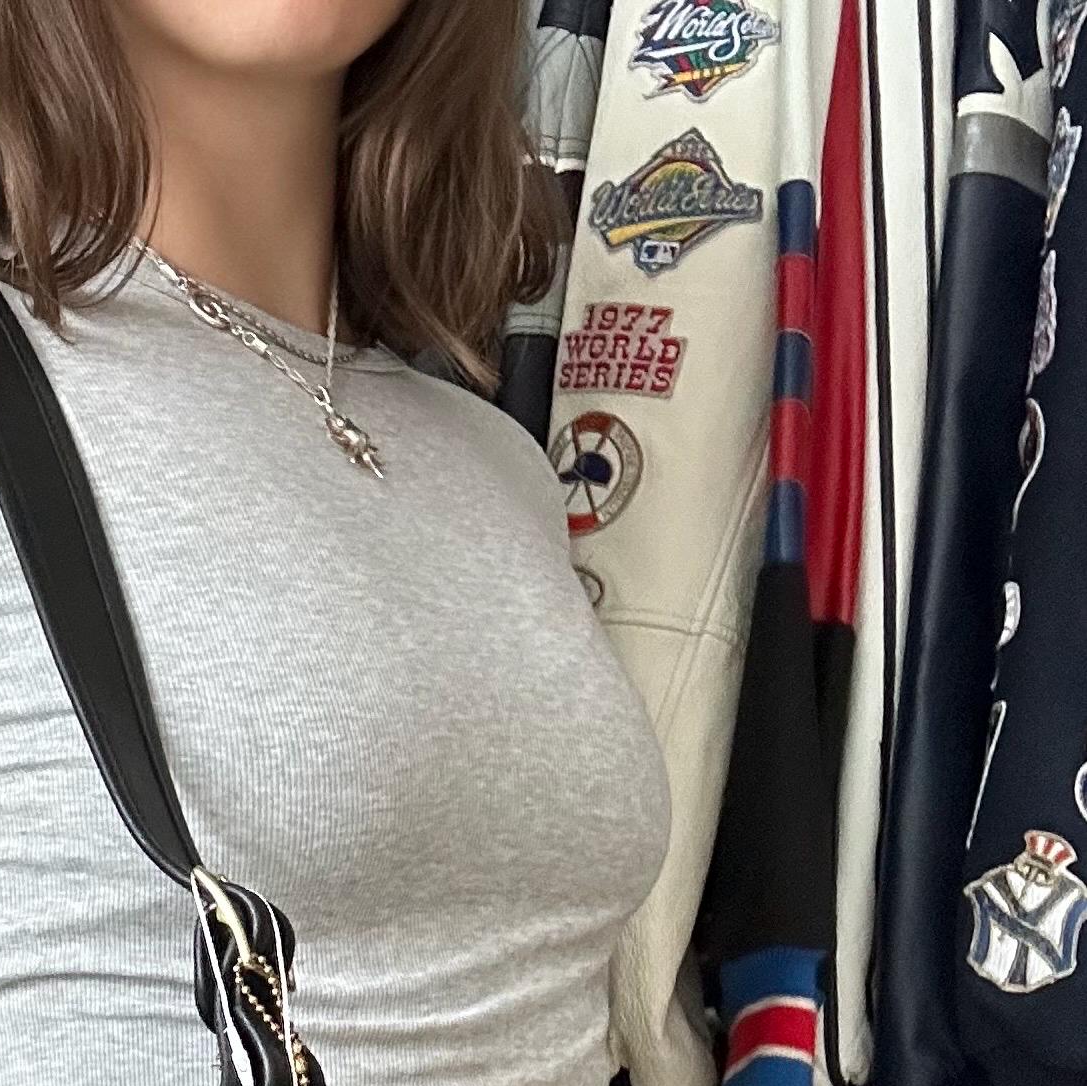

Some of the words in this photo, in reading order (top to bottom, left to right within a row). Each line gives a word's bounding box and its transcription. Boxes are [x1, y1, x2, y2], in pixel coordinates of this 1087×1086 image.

[583, 304, 673, 335] 1977
[565, 333, 682, 365] WORLD
[559, 361, 675, 392] SERIES
